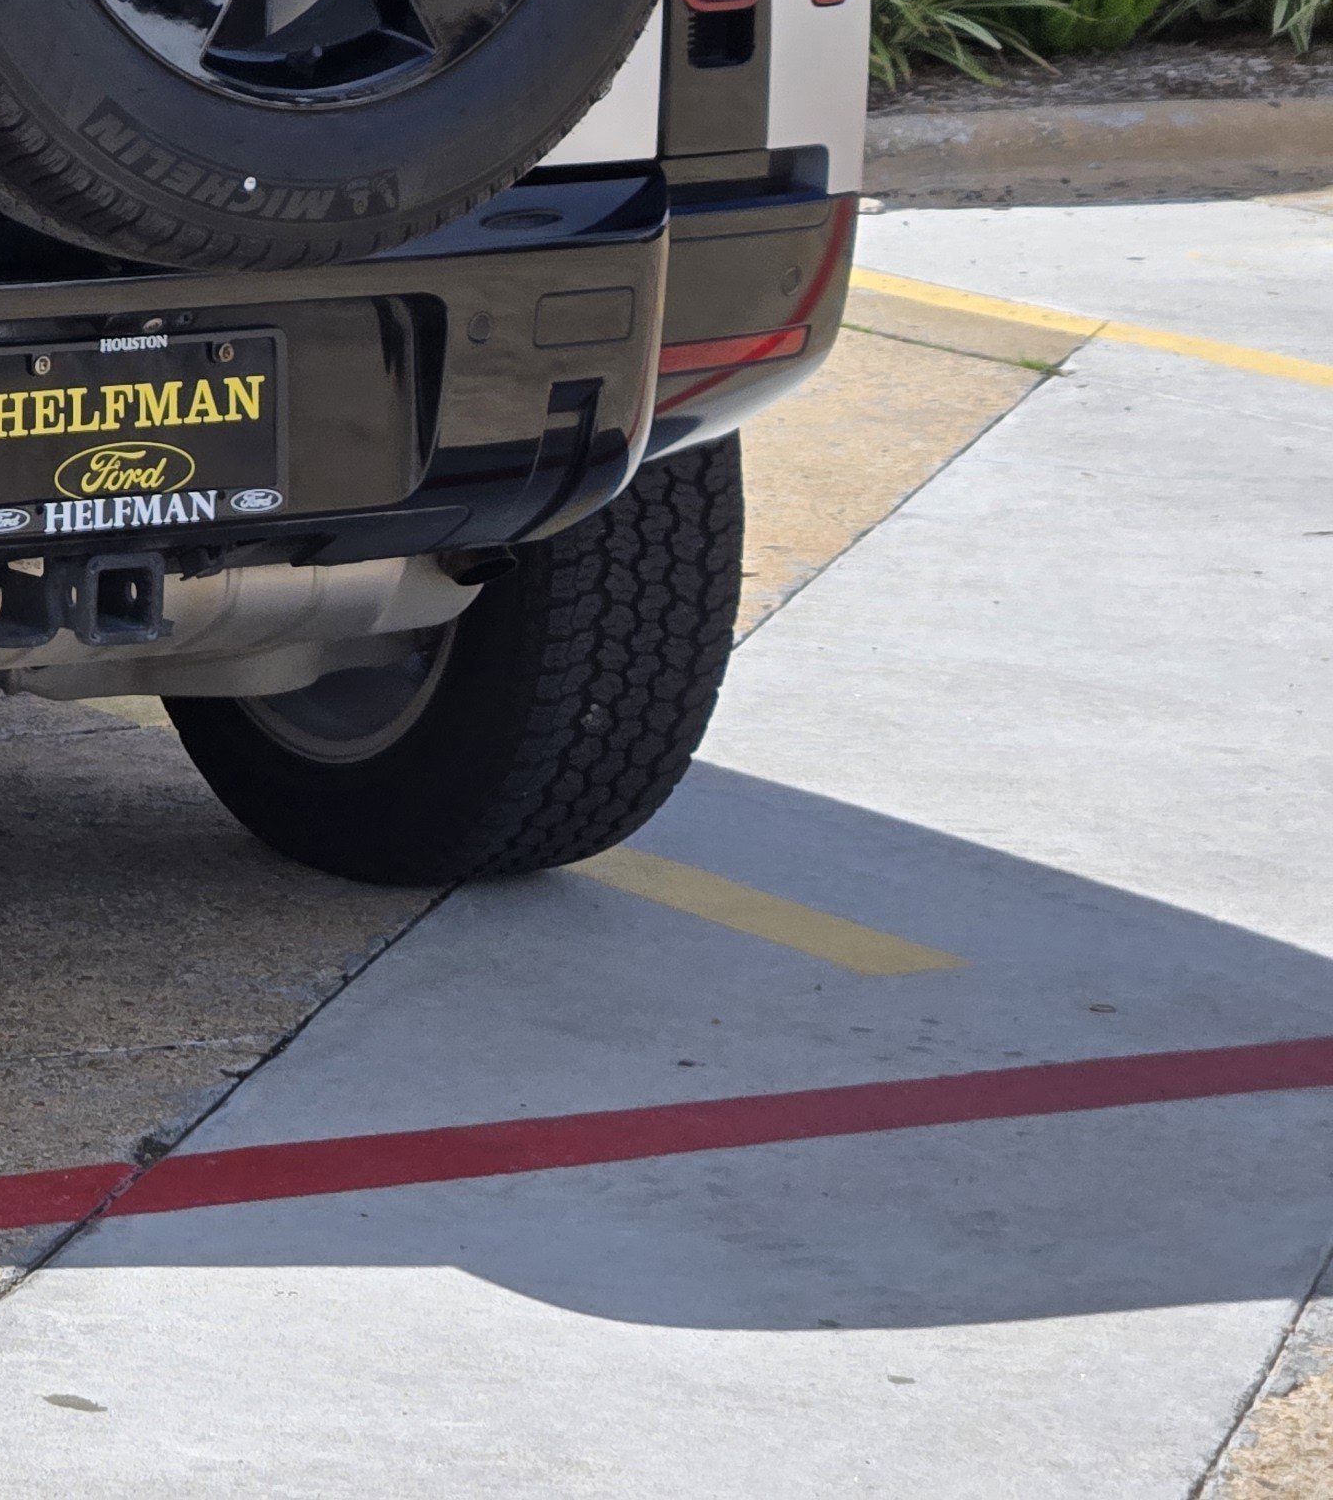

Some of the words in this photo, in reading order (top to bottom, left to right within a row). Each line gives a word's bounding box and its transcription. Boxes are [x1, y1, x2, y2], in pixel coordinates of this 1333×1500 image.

[100, 334, 168, 353] HOUSTON
[81, 450, 165, 492] Ford
[43, 490, 219, 534] HELFMAN
[240, 492, 274, 508] Ford
